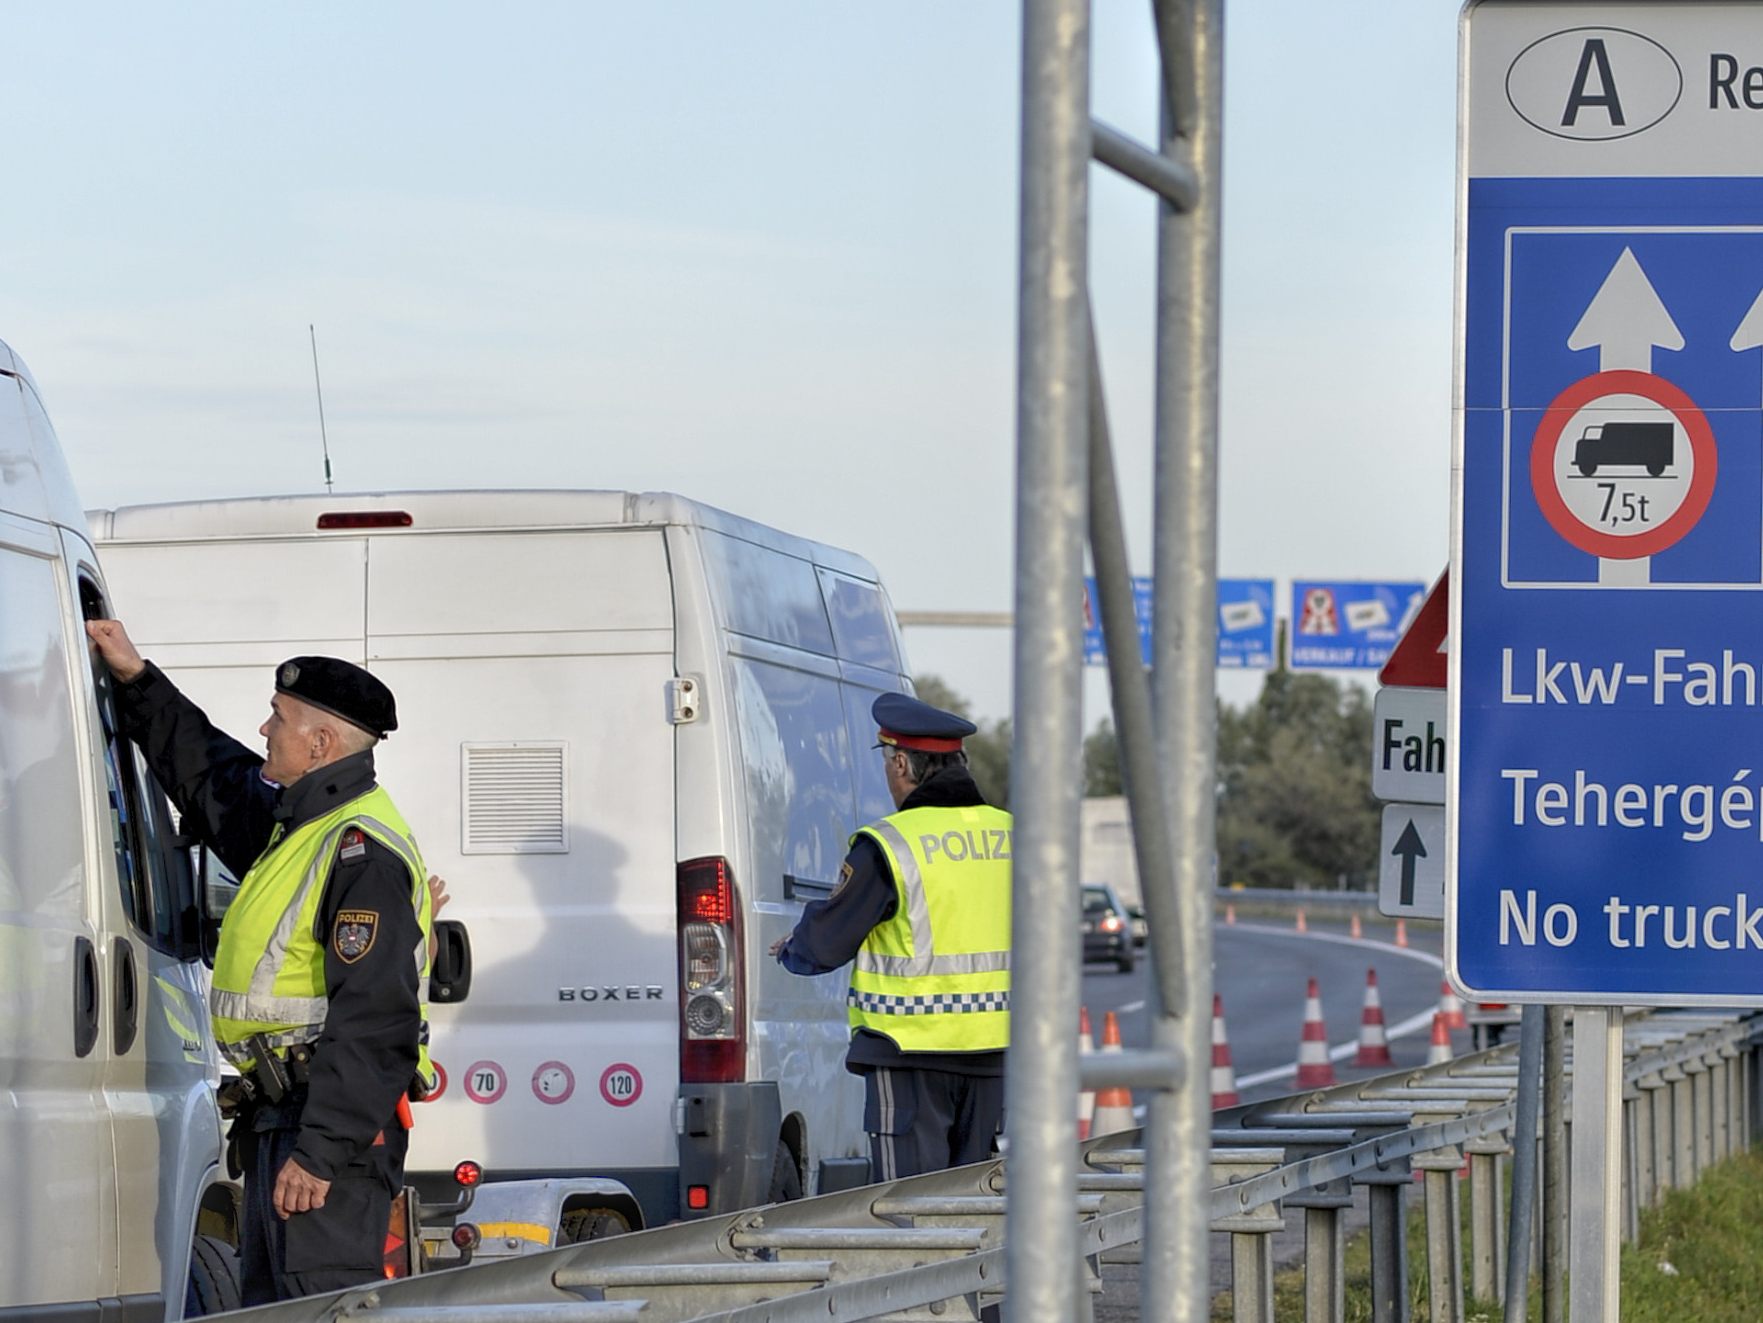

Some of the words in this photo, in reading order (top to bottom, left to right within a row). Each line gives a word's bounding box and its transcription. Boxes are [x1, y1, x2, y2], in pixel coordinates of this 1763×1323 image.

[1561, 38, 1626, 126] A
[1709, 53, 1763, 110] Re
[1597, 482, 1650, 527] 7,5t
[1502, 648, 1763, 706] Lkw-Fah
[1382, 719, 1445, 773] Fah
[1501, 769, 1763, 842] Tehergé
[919, 829, 1013, 864] POLIZ
[339, 913, 374, 923] POLIZEI
[1499, 889, 1579, 947] No
[1603, 892, 1763, 949] truck
[559, 985, 663, 1002] BOXER
[476, 1073, 495, 1092] 70
[610, 1075, 632, 1095] 120
